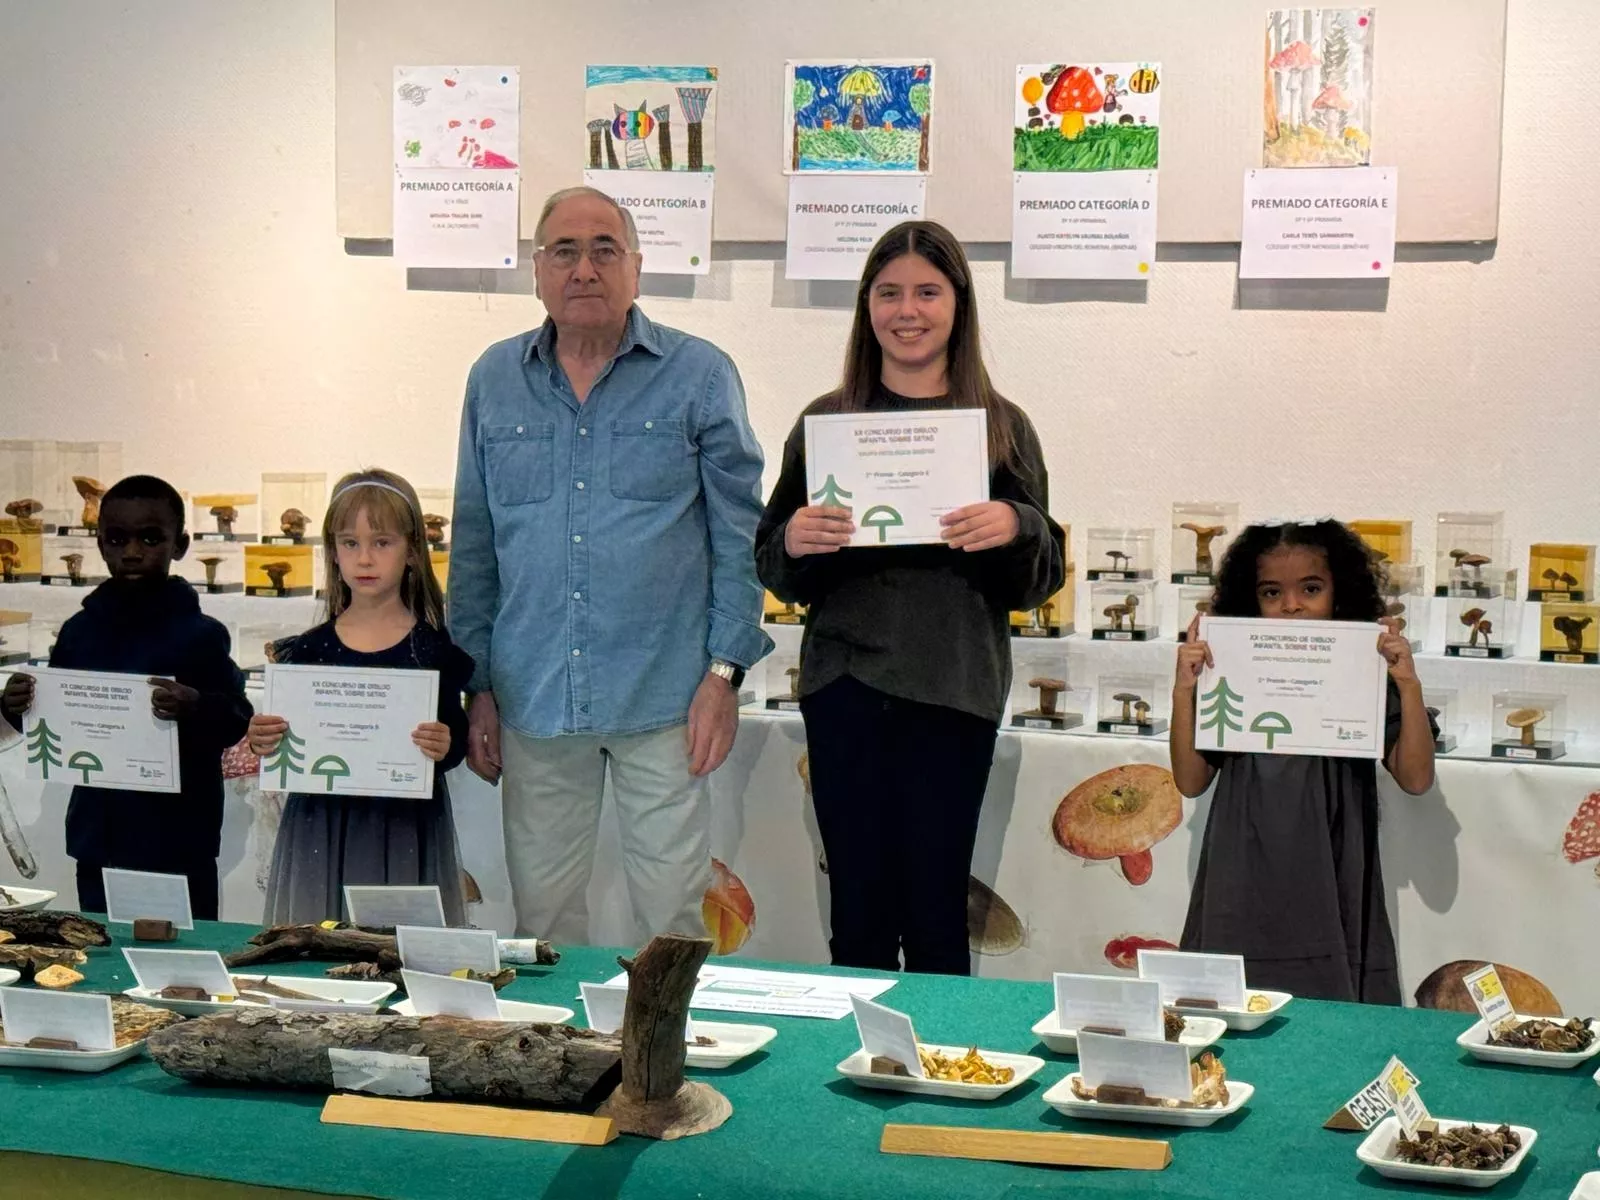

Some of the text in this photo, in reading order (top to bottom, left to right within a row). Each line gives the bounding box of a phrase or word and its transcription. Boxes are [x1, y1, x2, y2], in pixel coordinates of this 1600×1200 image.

[400, 180, 513, 192] PREMIADO CATEGORÍA A
[643, 197, 698, 209] CATEGORÍA
[700, 199, 706, 209] B
[795, 201, 918, 215] PREMIADO CATEGORÍA C
[1019, 198, 1150, 210] PREMIADO CATEGORÍA D
[1251, 195, 1389, 209] PREMIADO CATEGORÍA E
